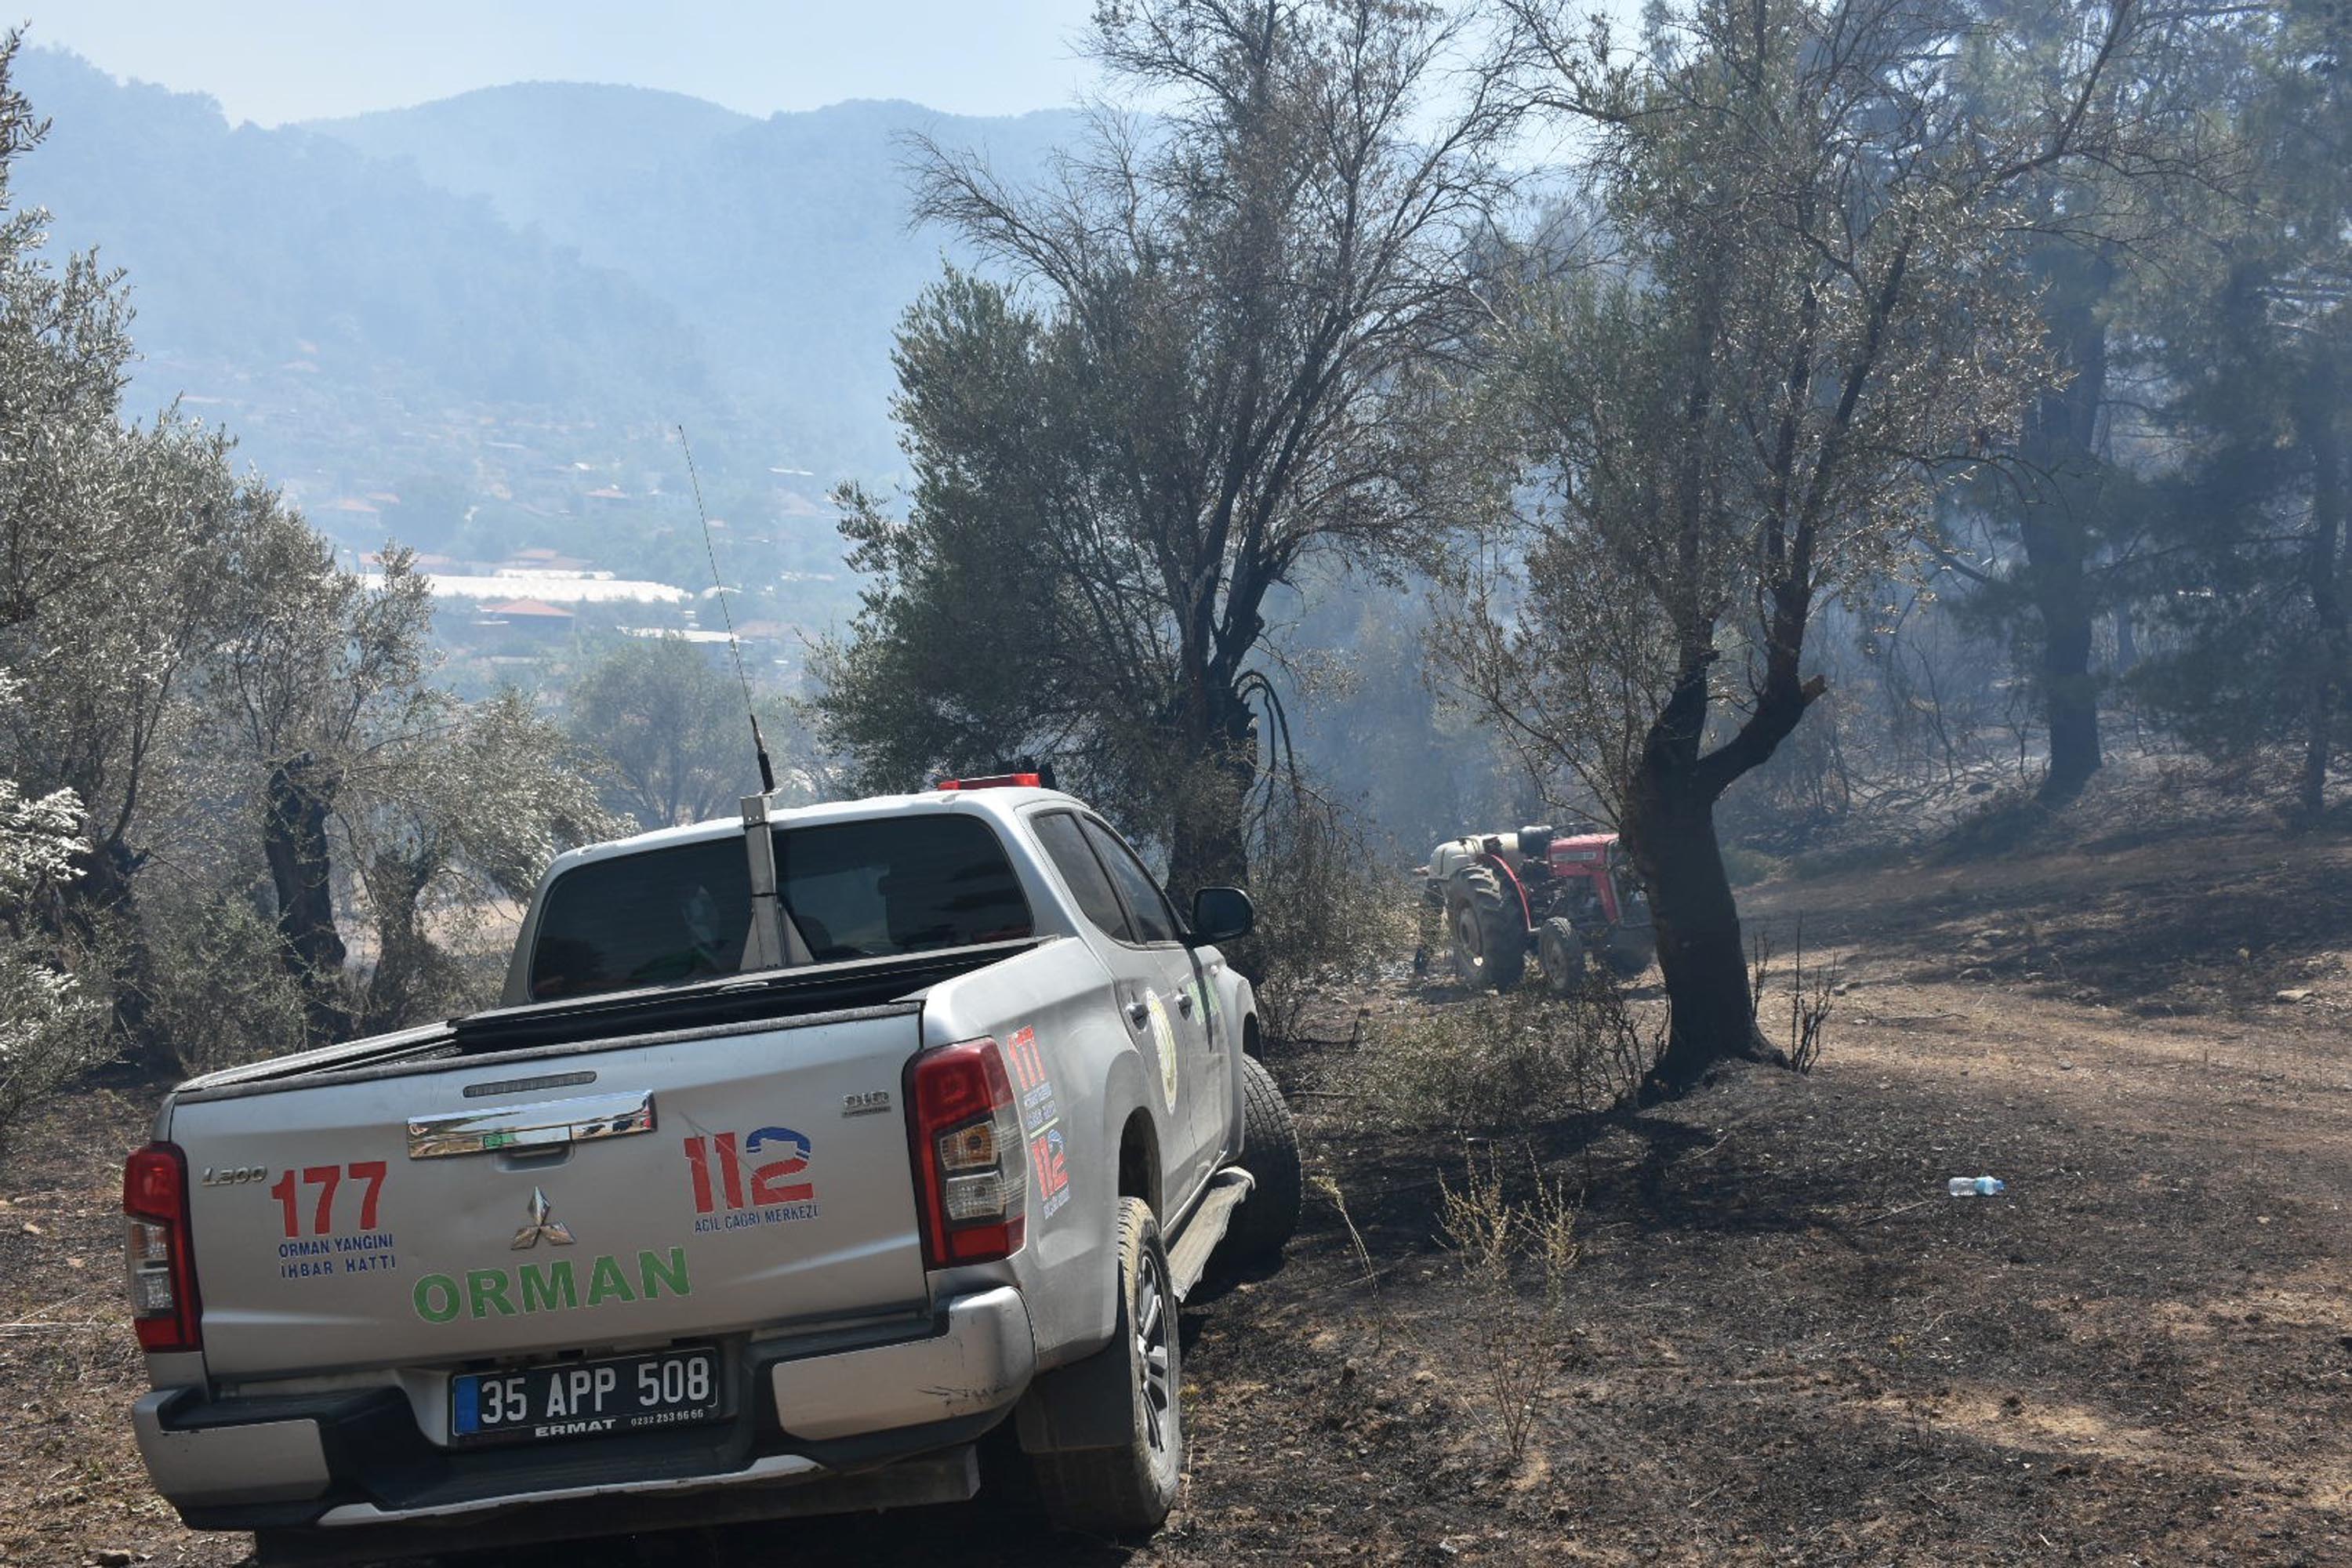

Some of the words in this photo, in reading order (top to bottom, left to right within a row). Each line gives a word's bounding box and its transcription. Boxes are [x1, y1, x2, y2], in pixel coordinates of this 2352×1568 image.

[270, 1161, 387, 1237] 177
[684, 1127, 815, 1214] 112
[278, 1240, 330, 1258] ORMAN
[335, 1233, 393, 1252] YANGINI
[346, 1255, 396, 1272] HATTI
[412, 1247, 691, 1324] ORMAN
[481, 1377, 528, 1424] 35
[546, 1367, 616, 1418] APP
[637, 1356, 710, 1406] 508
[535, 1418, 616, 1438] ERMAT
